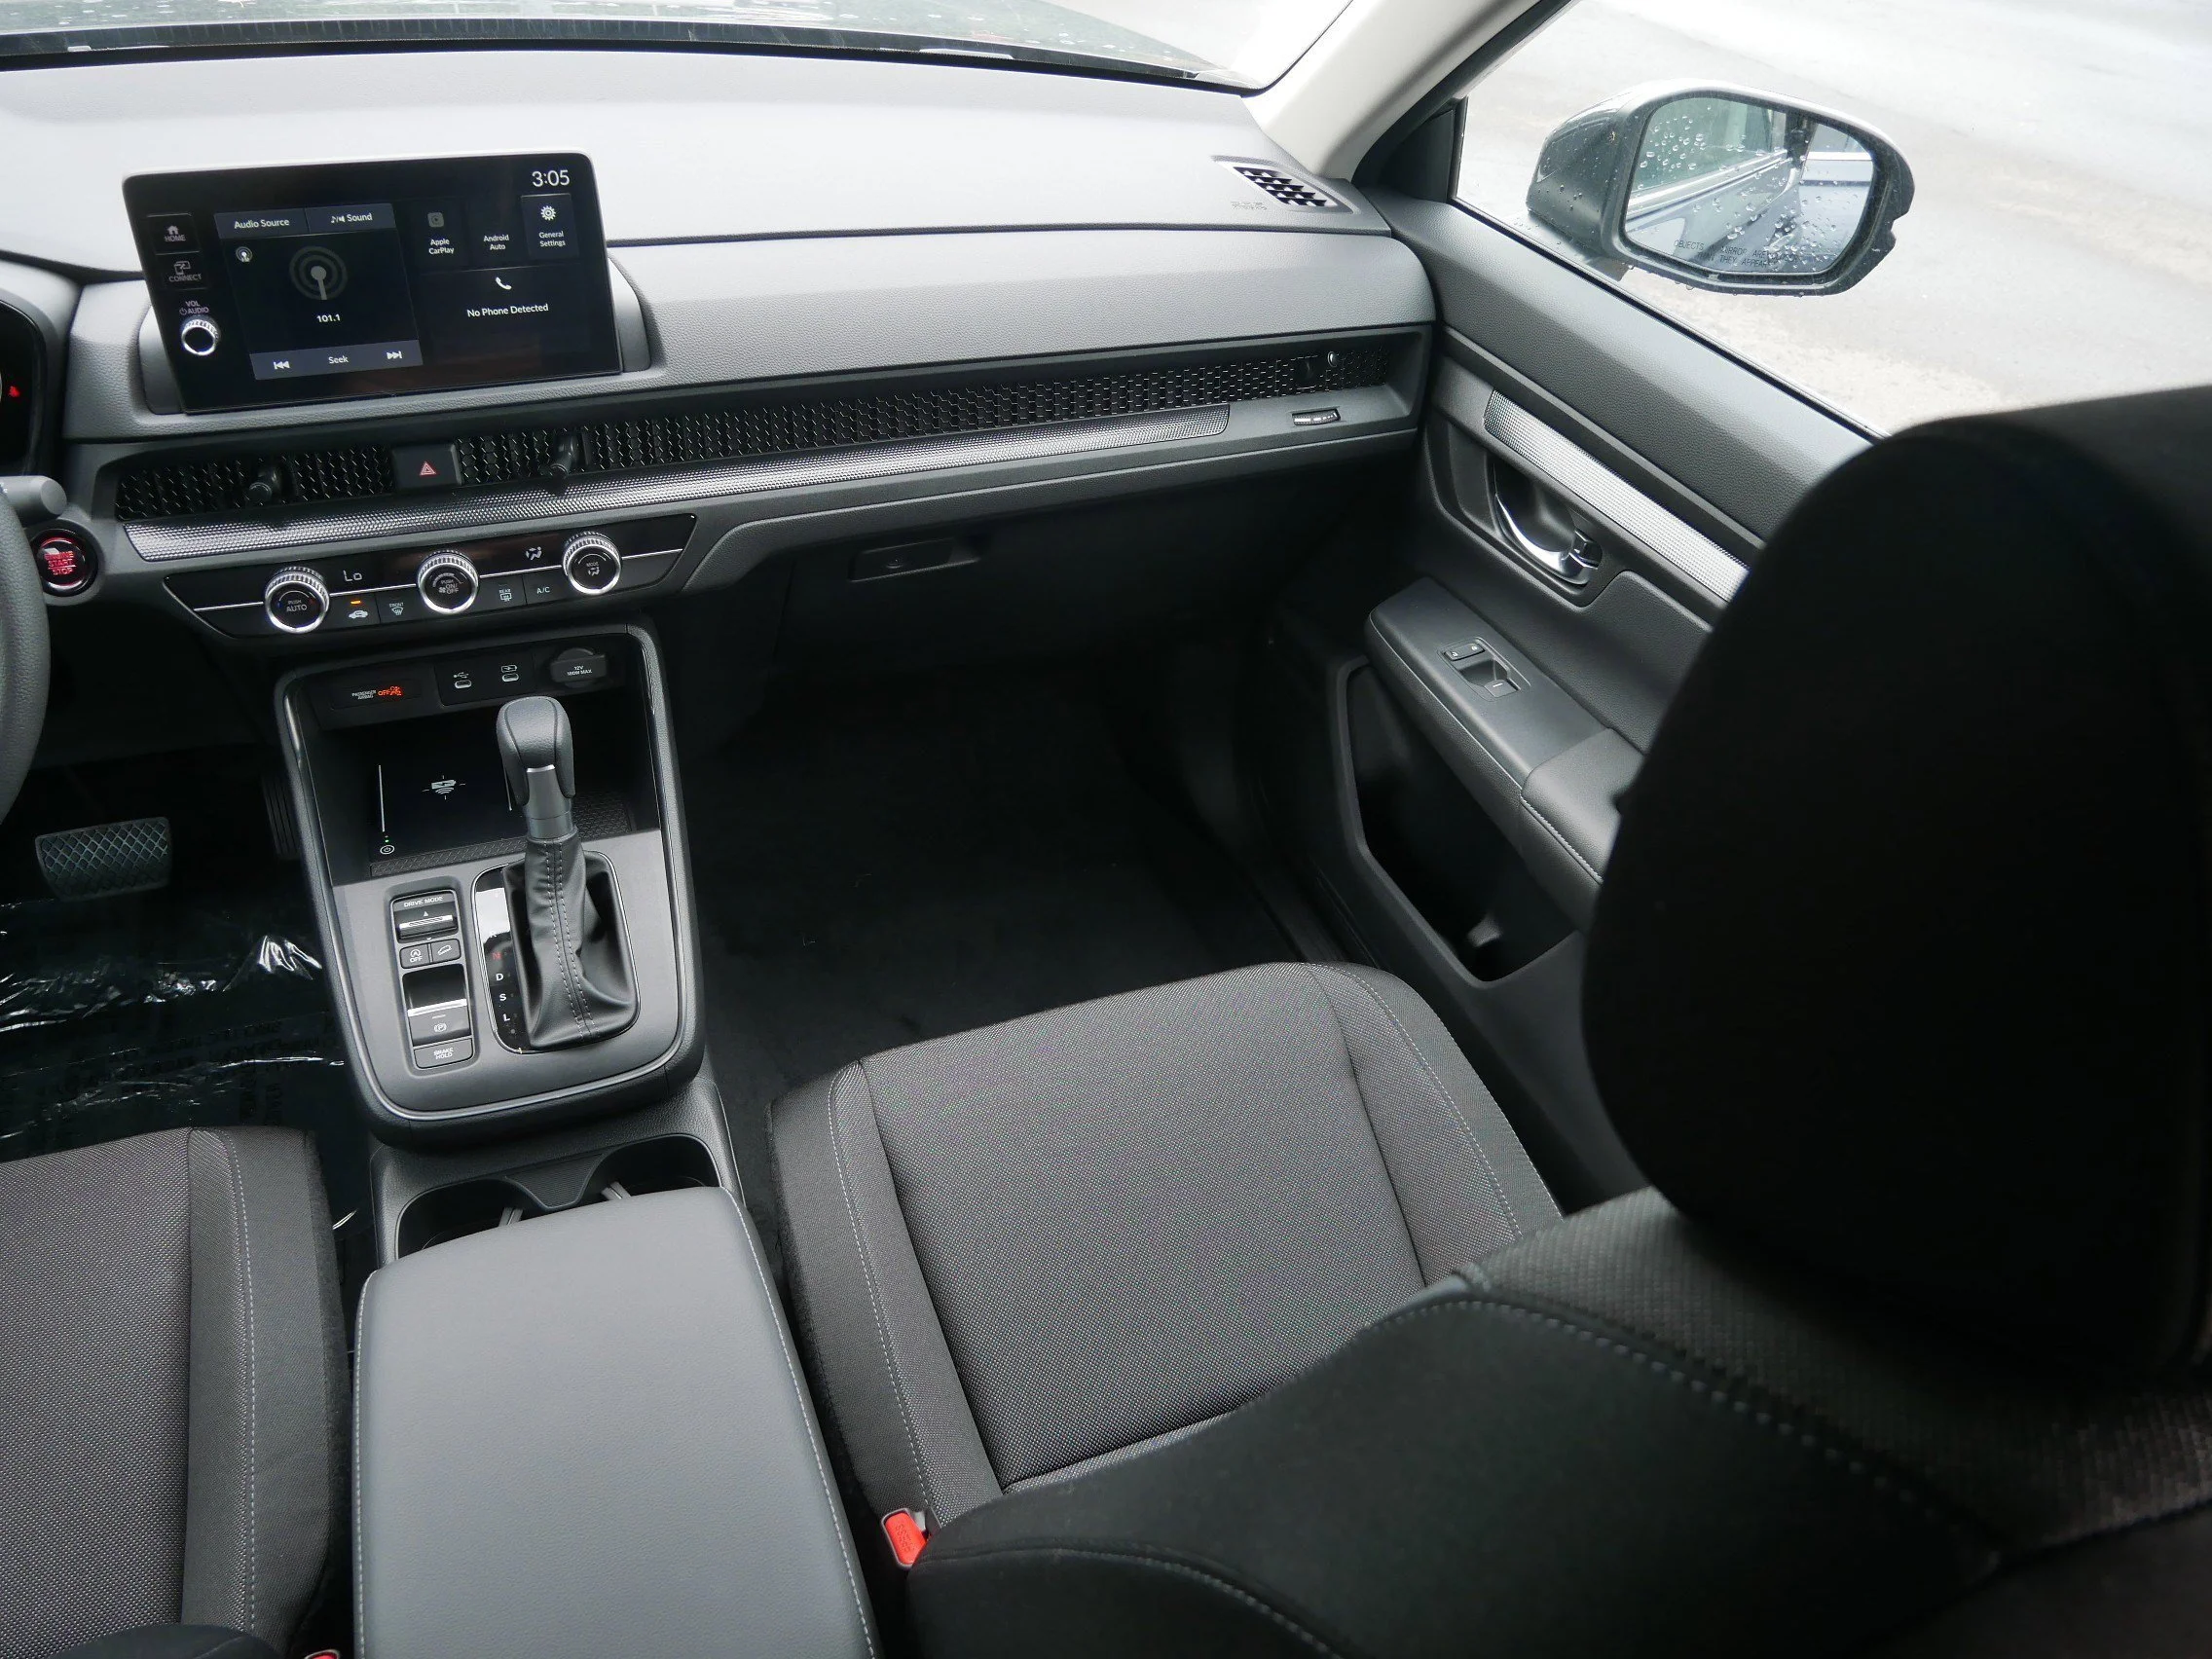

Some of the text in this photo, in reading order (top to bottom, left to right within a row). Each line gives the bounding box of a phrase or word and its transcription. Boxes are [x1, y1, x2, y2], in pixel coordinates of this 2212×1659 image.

[532, 169, 571, 188] 3:05
[347, 212, 373, 222] Sound
[234, 218, 290, 230] Audio Source
[483, 234, 510, 242] Android
[429, 239, 451, 247] Apple
[539, 239, 566, 248] Settings
[428, 246, 455, 255] CarPlay
[168, 274, 203, 282] CONNECT
[466, 303, 549, 318] No Phone Detected
[316, 313, 341, 323] 101.1
[328, 354, 350, 365] Seek
[48, 559, 73, 568] START
[52, 567, 73, 575] STOP
[343, 570, 363, 582] Lo
[536, 586, 550, 595] A/C
[285, 604, 308, 613] AUTO
[403, 895, 444, 907] DRIVE MODE
[499, 993, 507, 1002] S
[502, 1014, 511, 1022] L
[435, 1051, 453, 1060] HOLD
